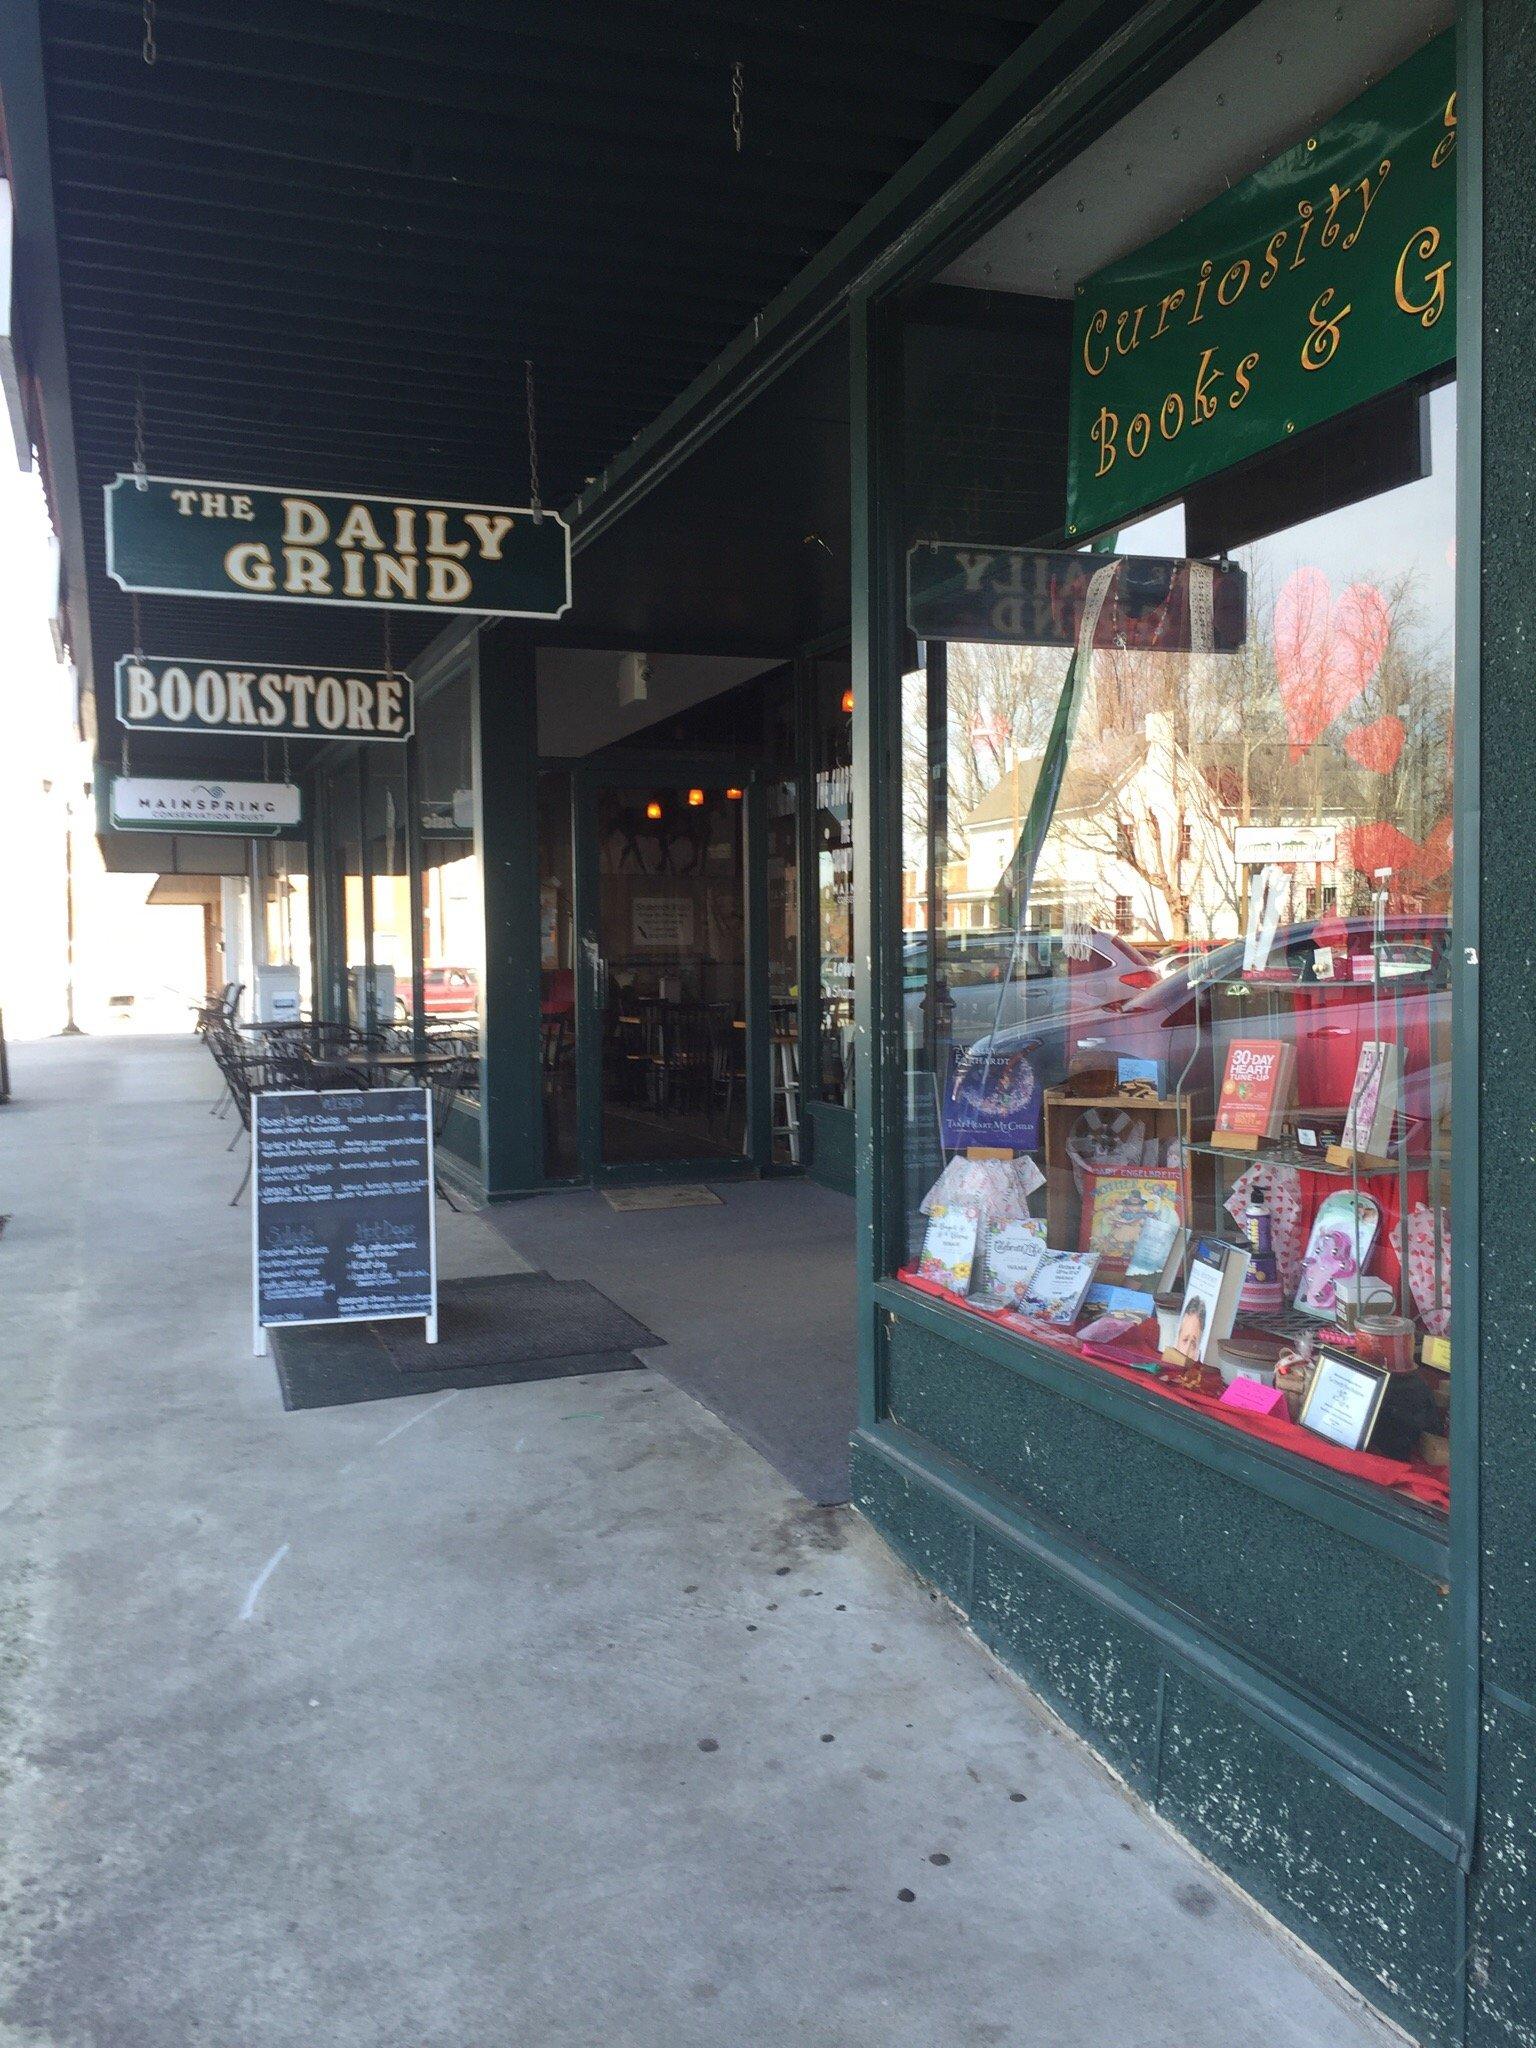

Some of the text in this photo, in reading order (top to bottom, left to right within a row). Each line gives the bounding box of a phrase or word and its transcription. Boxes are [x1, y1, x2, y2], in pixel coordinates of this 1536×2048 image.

[1083, 160, 1391, 377] Curiosity
[1091, 346, 1259, 478] Books
[1301, 287, 1352, 371] &
[170, 488, 515, 560] THE DAILY
[224, 542, 474, 603] GRIND
[127, 665, 405, 733] BOOKSTORE
[139, 798, 276, 813] MAINSPRING
[152, 810, 265, 821] CONSERVATION TRUST
[1230, 1064, 1272, 1075] HEART
[1232, 1049, 1276, 1066] 30-DAY
[1229, 1073, 1270, 1082] TUNE-UP
